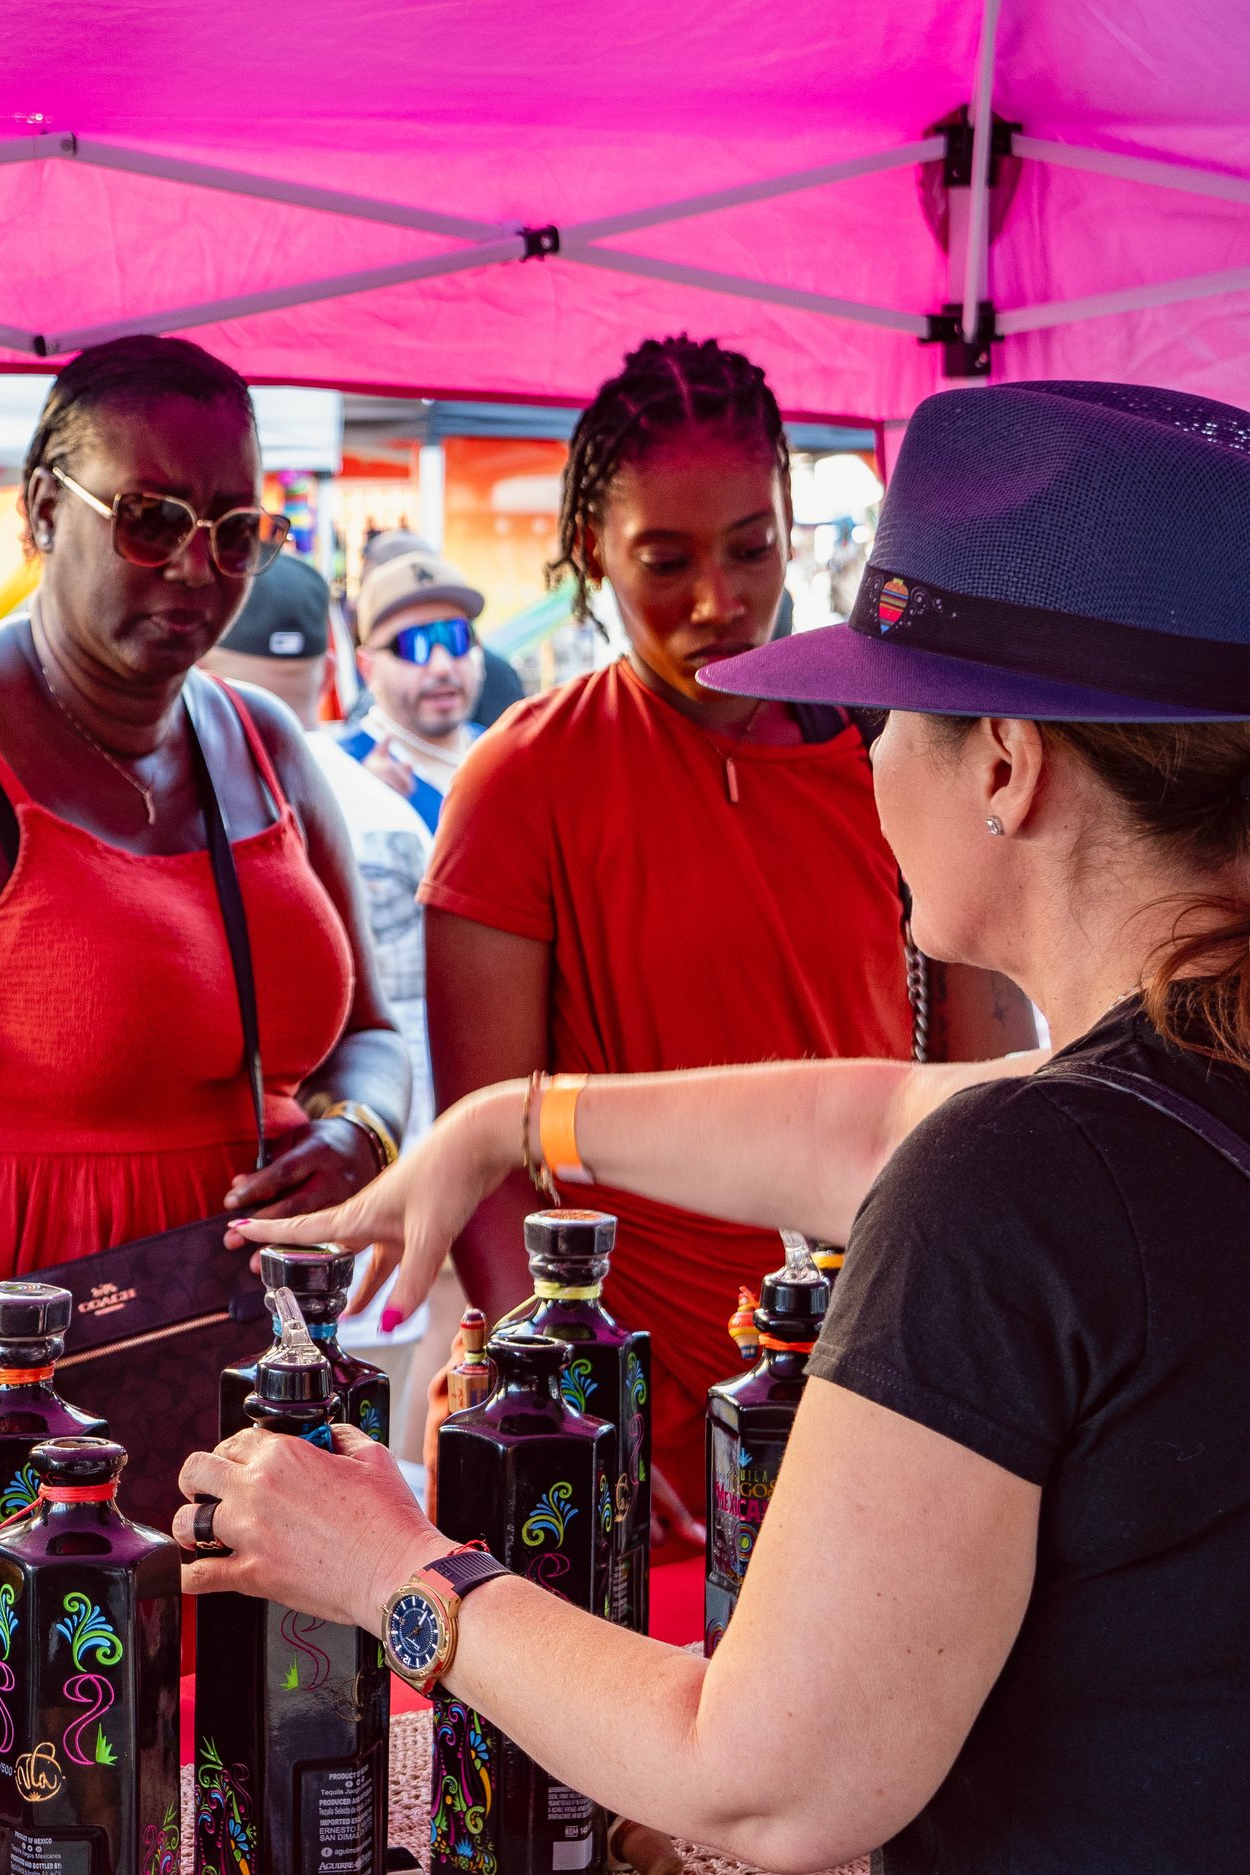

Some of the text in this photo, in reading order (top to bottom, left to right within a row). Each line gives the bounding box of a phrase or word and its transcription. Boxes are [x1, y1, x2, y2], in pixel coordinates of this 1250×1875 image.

[329, 1772, 356, 1780] PRODUCT
[320, 1788, 343, 1797] Tequila
[319, 1798, 350, 1806] PRODUCED
[319, 1818, 350, 1826] IMPORTED
[319, 1826, 356, 1835] ERNESTO
[319, 1834, 336, 1842] SAN
[32, 1862, 53, 1870] BOTTLED
